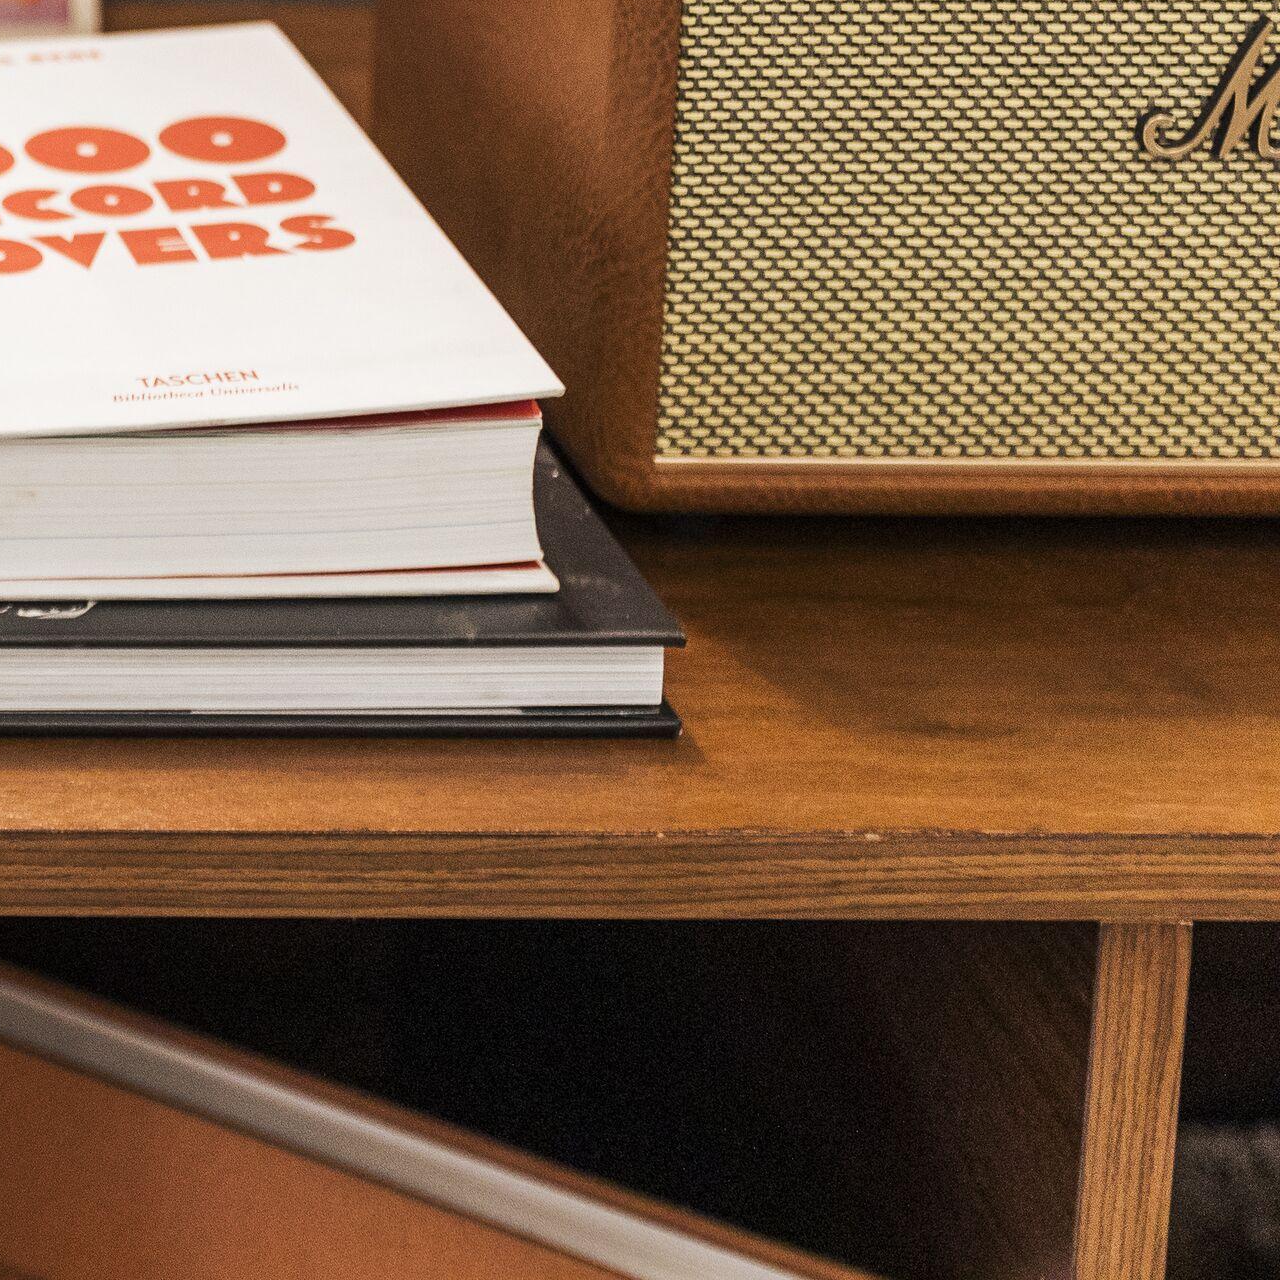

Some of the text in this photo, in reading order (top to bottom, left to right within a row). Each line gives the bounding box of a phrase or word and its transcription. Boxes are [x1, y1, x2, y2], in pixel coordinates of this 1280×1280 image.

[137, 369, 260, 388] TASCHEN
[113, 382, 300, 403] Bibliotheca Universalis
